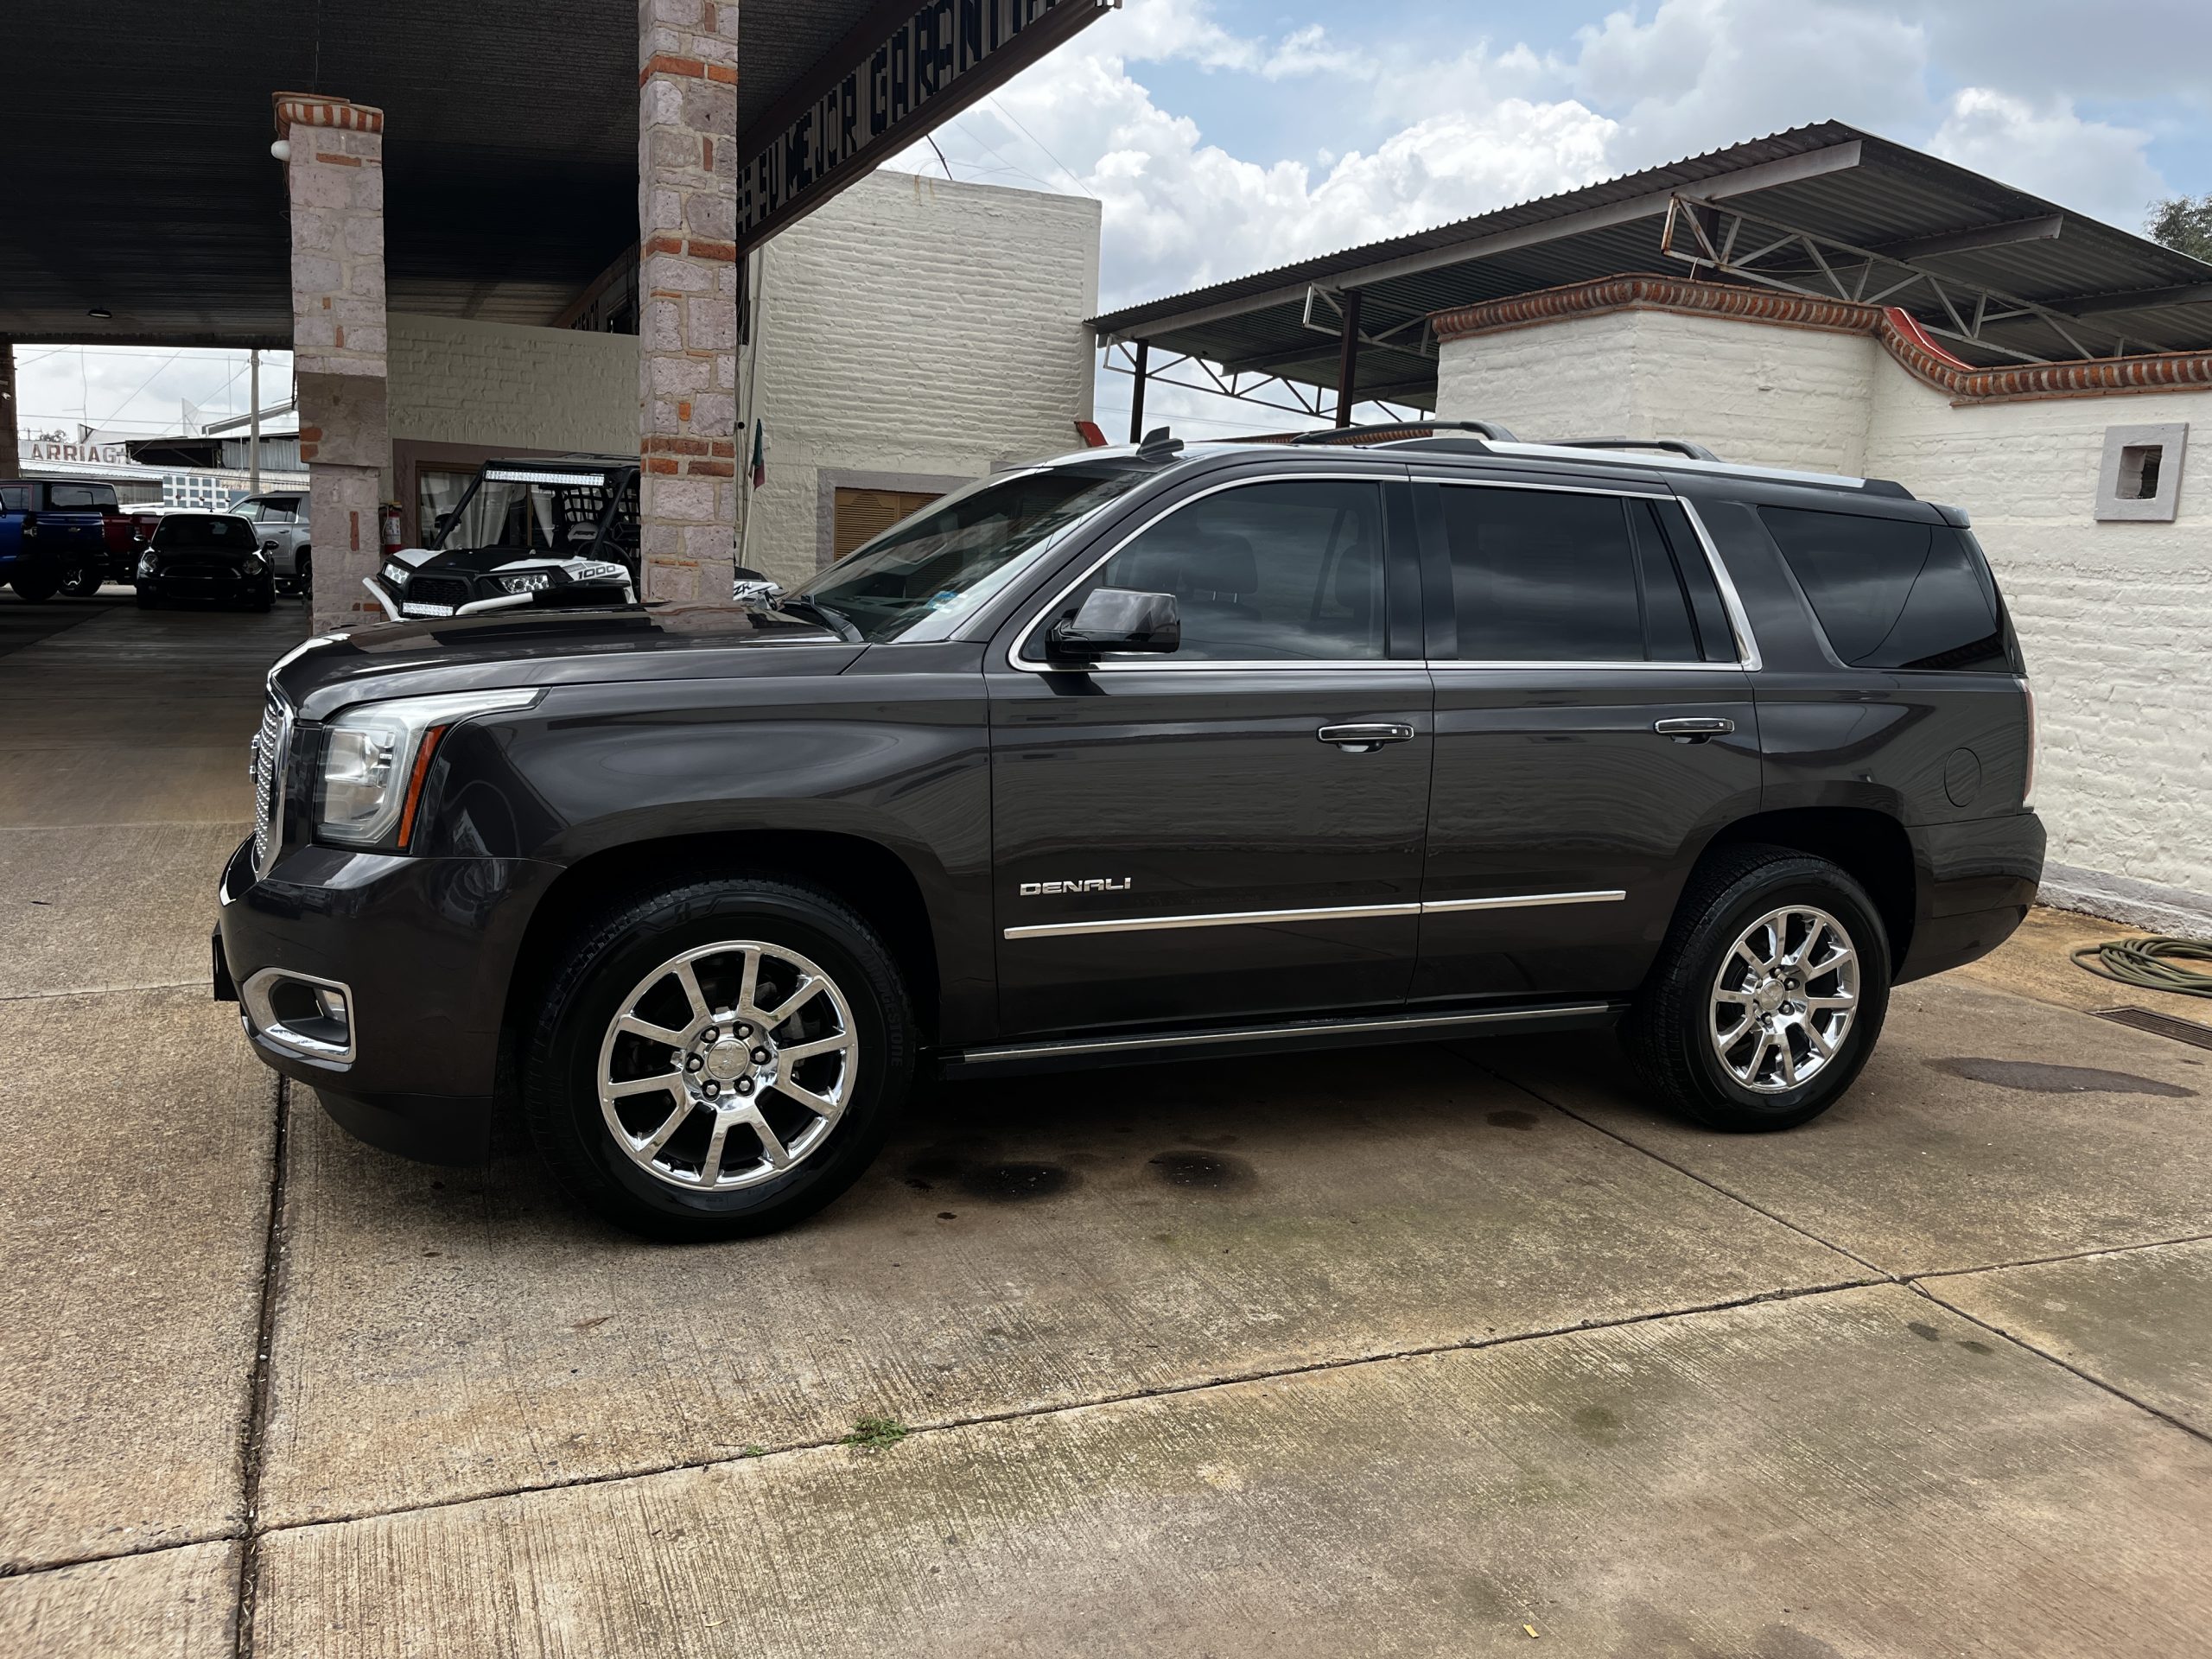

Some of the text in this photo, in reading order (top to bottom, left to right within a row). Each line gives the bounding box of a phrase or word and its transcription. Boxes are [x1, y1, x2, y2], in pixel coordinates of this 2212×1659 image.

[785, 74, 857, 201] MEJOR
[31, 443, 126, 464] ARRIAG
[577, 565, 616, 580] 1000
[1020, 877, 1132, 896] DENALI
